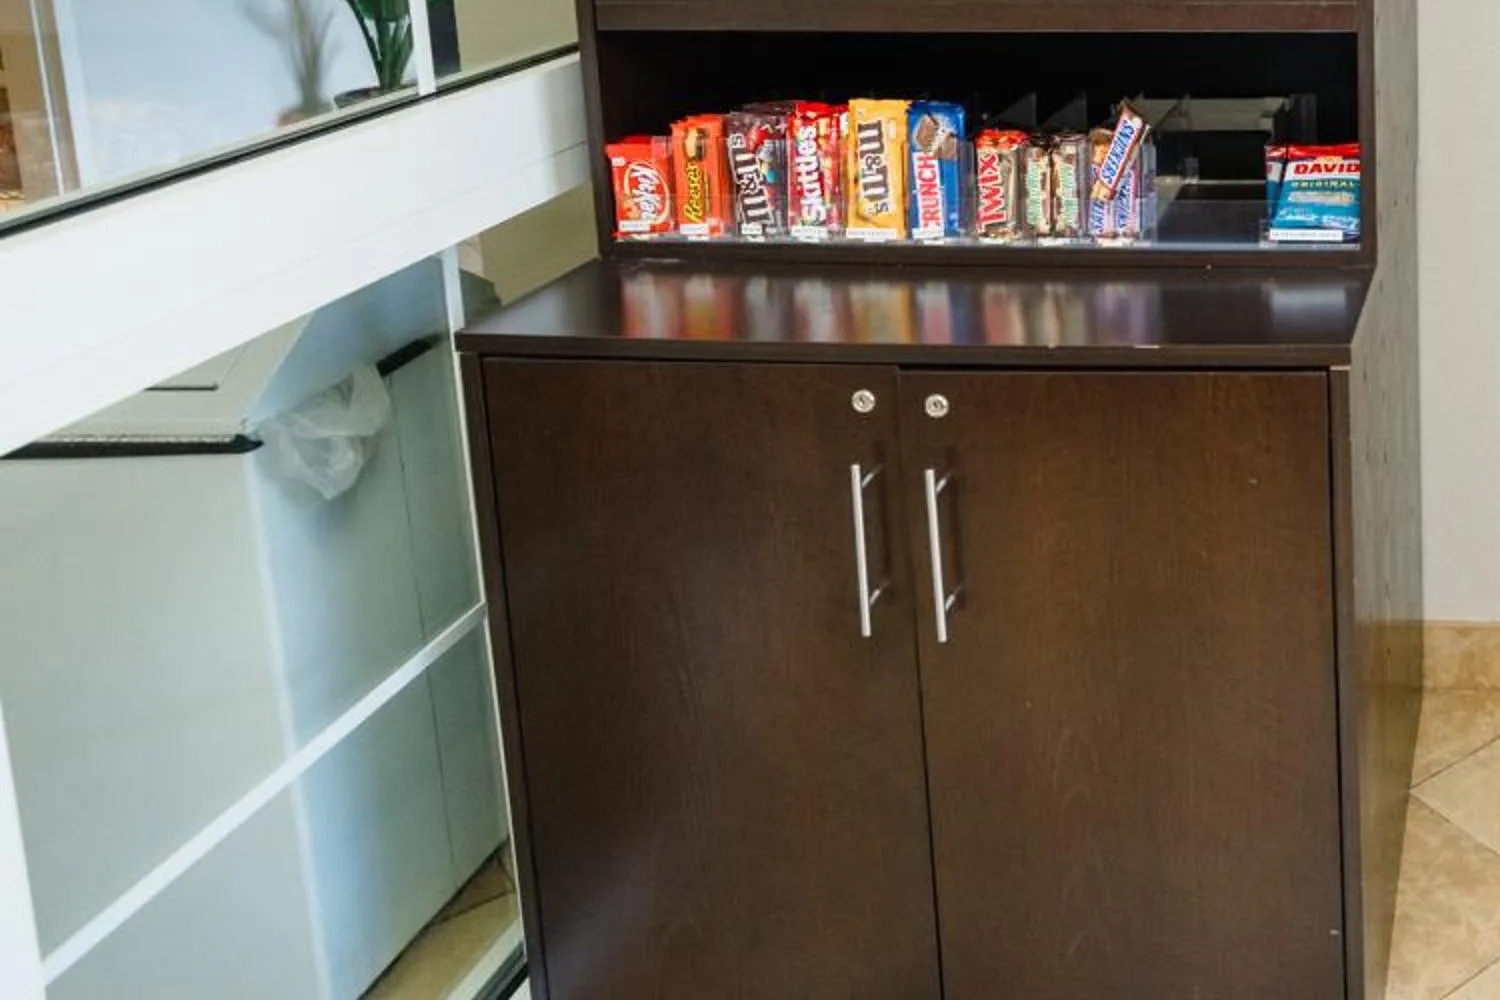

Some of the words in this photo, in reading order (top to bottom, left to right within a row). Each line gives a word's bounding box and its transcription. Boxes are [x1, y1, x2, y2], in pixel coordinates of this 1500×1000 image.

[683, 164, 703, 223] Reese's
[796, 126, 827, 222] Skittles
[976, 151, 1006, 231] TWIX
[1294, 164, 1361, 175] DAVID
